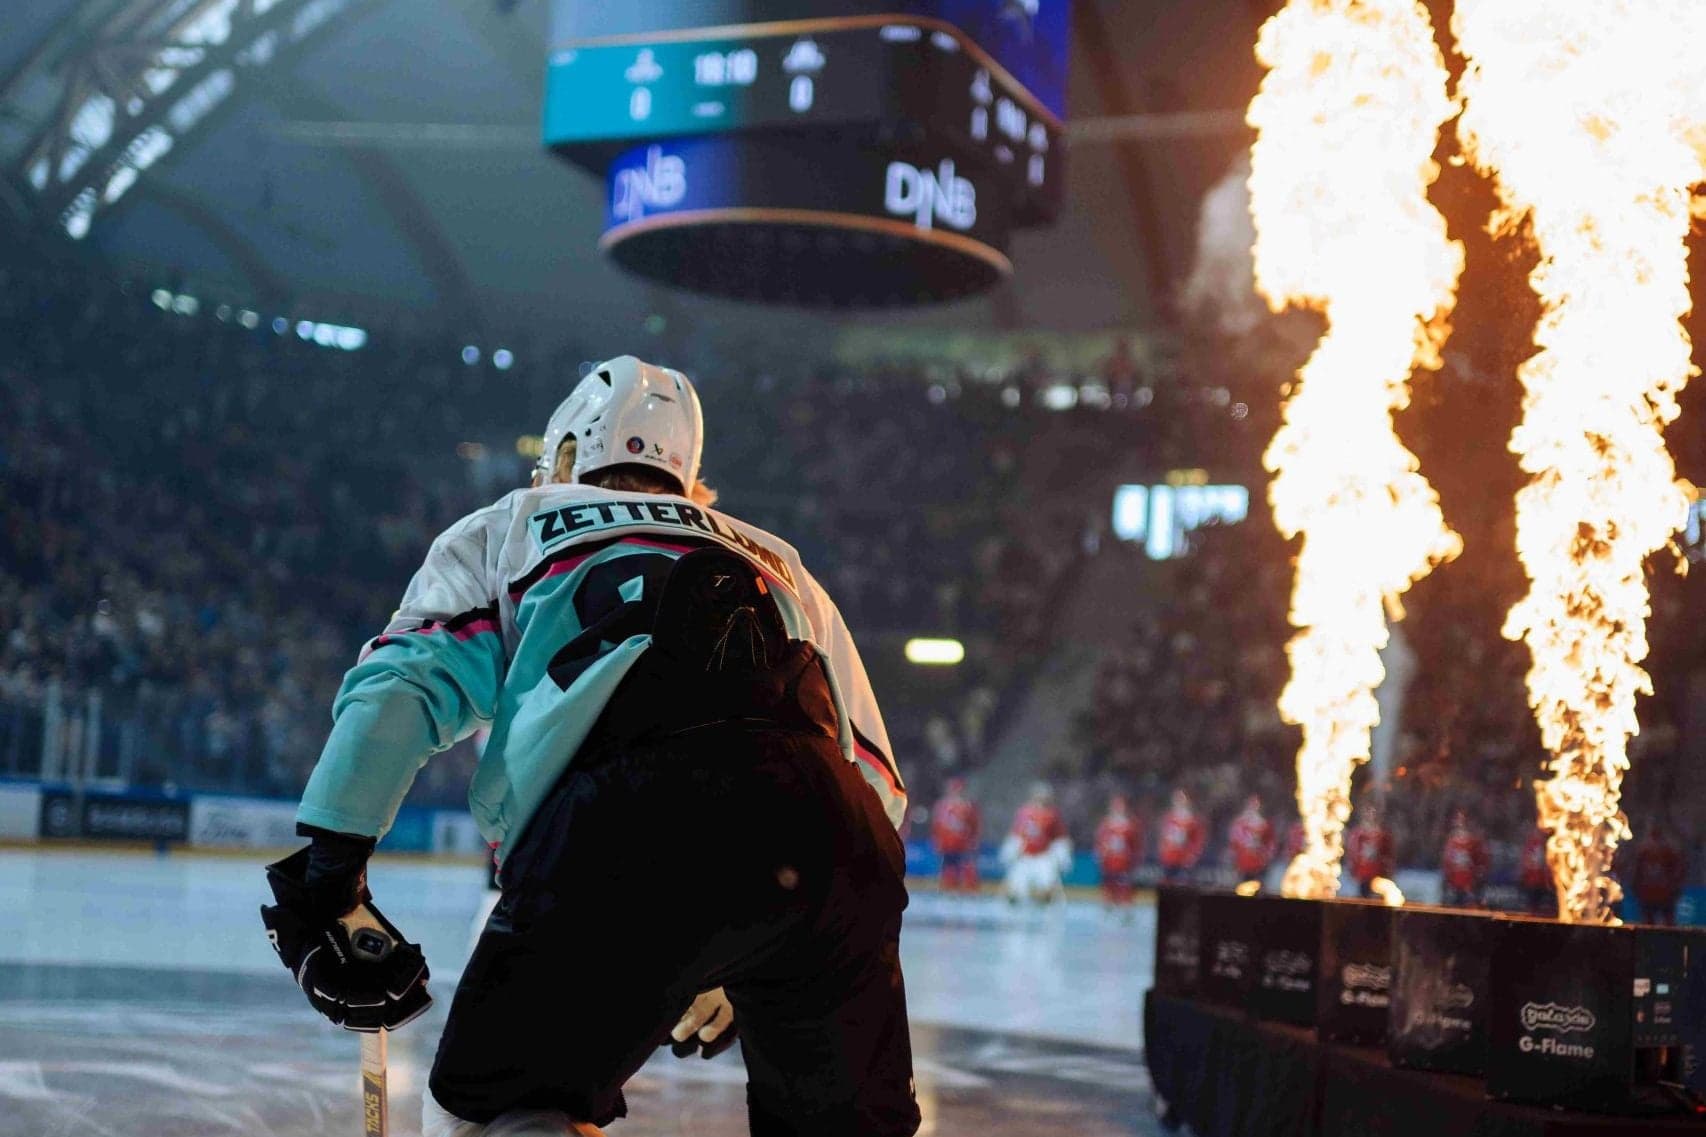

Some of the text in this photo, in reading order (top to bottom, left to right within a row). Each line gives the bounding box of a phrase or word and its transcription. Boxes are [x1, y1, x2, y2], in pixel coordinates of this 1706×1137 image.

[613, 144, 686, 221] DNB
[885, 158, 976, 230] DNB
[1519, 1036, 1595, 1058] G-Flame
[365, 1091, 380, 1133] TACKS
